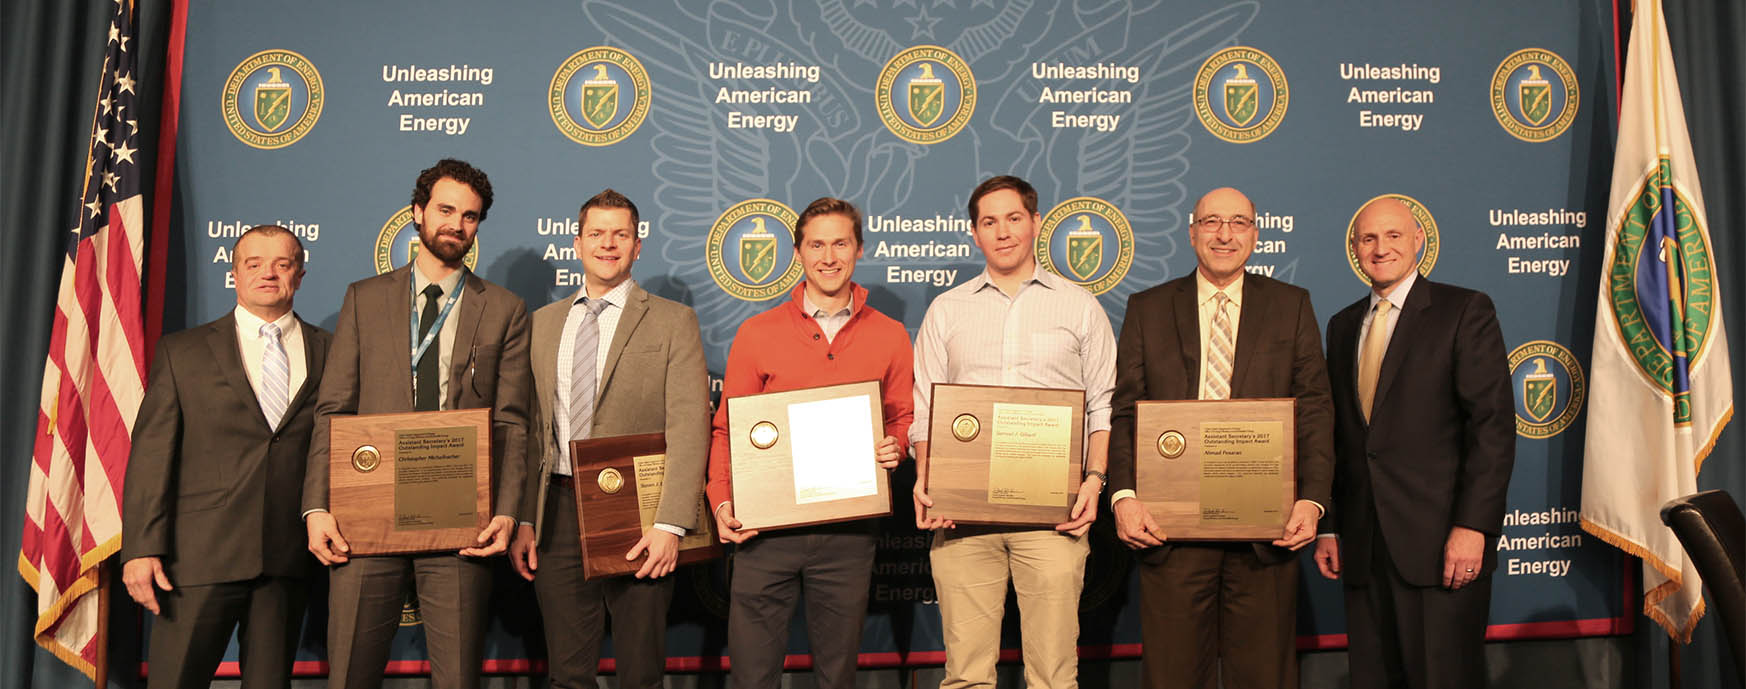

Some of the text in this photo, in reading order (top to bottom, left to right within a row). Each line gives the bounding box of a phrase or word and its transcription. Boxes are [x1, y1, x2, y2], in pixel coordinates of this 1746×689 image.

[226, 52, 321, 95] DEPARTMENT OF ENERGY
[383, 64, 493, 85] Unleashing
[552, 49, 648, 92] DEPARTMENT OF ENERGY
[709, 63, 820, 82] Unleashing
[879, 49, 973, 90] DEPARTMENT OF ENERGY
[1032, 63, 1139, 83] Unleashing
[1196, 50, 1285, 90] DEPARTMENT OF ENERGY
[1340, 63, 1440, 83] Unleashing
[1493, 51, 1577, 90] DEPARTMENT OF ENERGY
[388, 89, 483, 106] American
[715, 87, 811, 104] American
[1039, 87, 1131, 103] American
[1347, 87, 1434, 103] American
[225, 99, 321, 146] UNITED STATES OF AMERICA
[400, 114, 470, 135] Energy
[552, 95, 648, 143] UNITED STATES OF AMERICA
[728, 112, 798, 132] Energy
[878, 93, 974, 141] UNITED STATES OF AMERICA
[1052, 111, 1120, 131] Energy
[1196, 94, 1286, 140] UNITED STATES OF AMERICA
[1360, 111, 1423, 130] Energy
[1493, 94, 1577, 139] UNITED STATES OF AMERICA
[710, 202, 767, 244] DEPARTMENT
[765, 204, 779, 217] OF
[1038, 200, 1131, 243] DEPARTMENT OF ENERGY
[1489, 209, 1587, 228] Unleashing
[874, 240, 970, 258] American
[1496, 233, 1580, 250] American
[709, 250, 732, 287] UNITED
[728, 280, 764, 298] STATES
[763, 283, 778, 297] OF
[887, 266, 957, 287] Energy
[1104, 246, 1132, 287] AMERICA
[1508, 257, 1570, 277] Energy
[1503, 507, 1581, 527] nleashin
[1496, 533, 1582, 551] American
[1507, 558, 1571, 577] Energy
